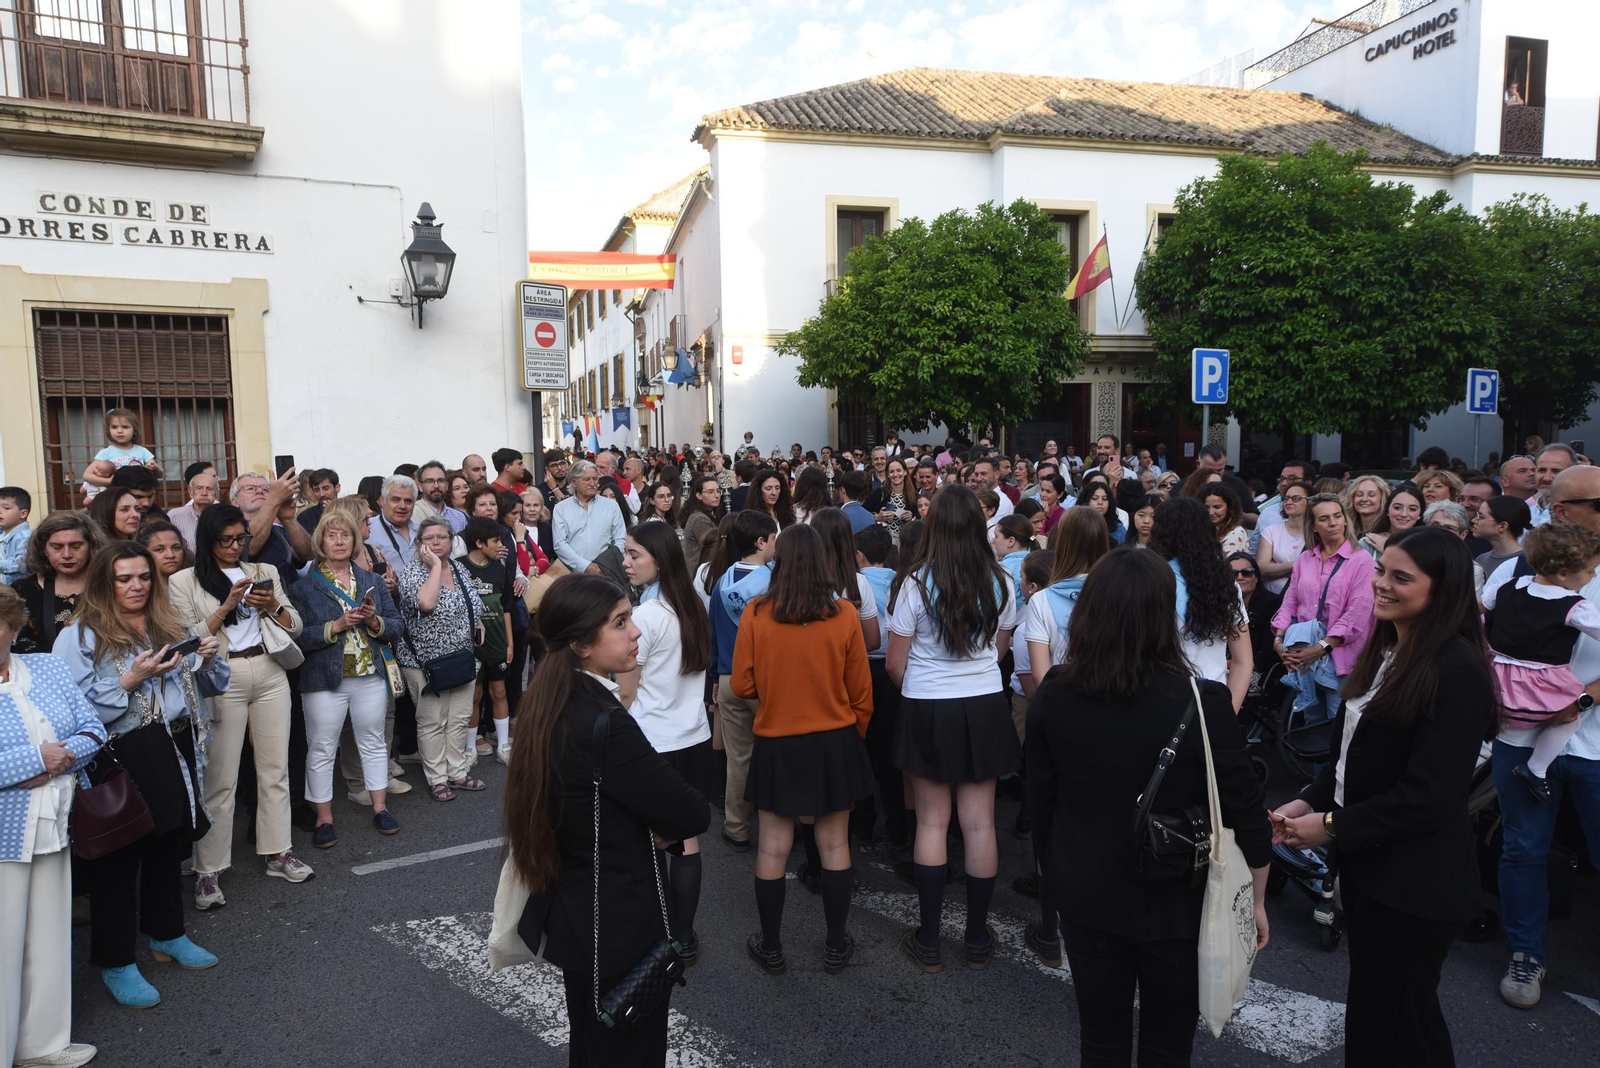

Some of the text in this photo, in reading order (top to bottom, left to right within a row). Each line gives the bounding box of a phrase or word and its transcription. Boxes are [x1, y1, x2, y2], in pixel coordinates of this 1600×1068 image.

[1364, 8, 1458, 62] CAPUCHINOS
[1413, 29, 1457, 60] HOTEL
[39, 193, 207, 224] CONDE DE
[123, 226, 271, 251] CABRERA
[549, 266, 581, 274] DIVINA
[585, 266, 629, 275] PASTORA!
[525, 295, 562, 304] RESTRINGIDA
[536, 288, 552, 296] ÁREA
[1202, 357, 1222, 396] P
[1474, 375, 1492, 408] P
